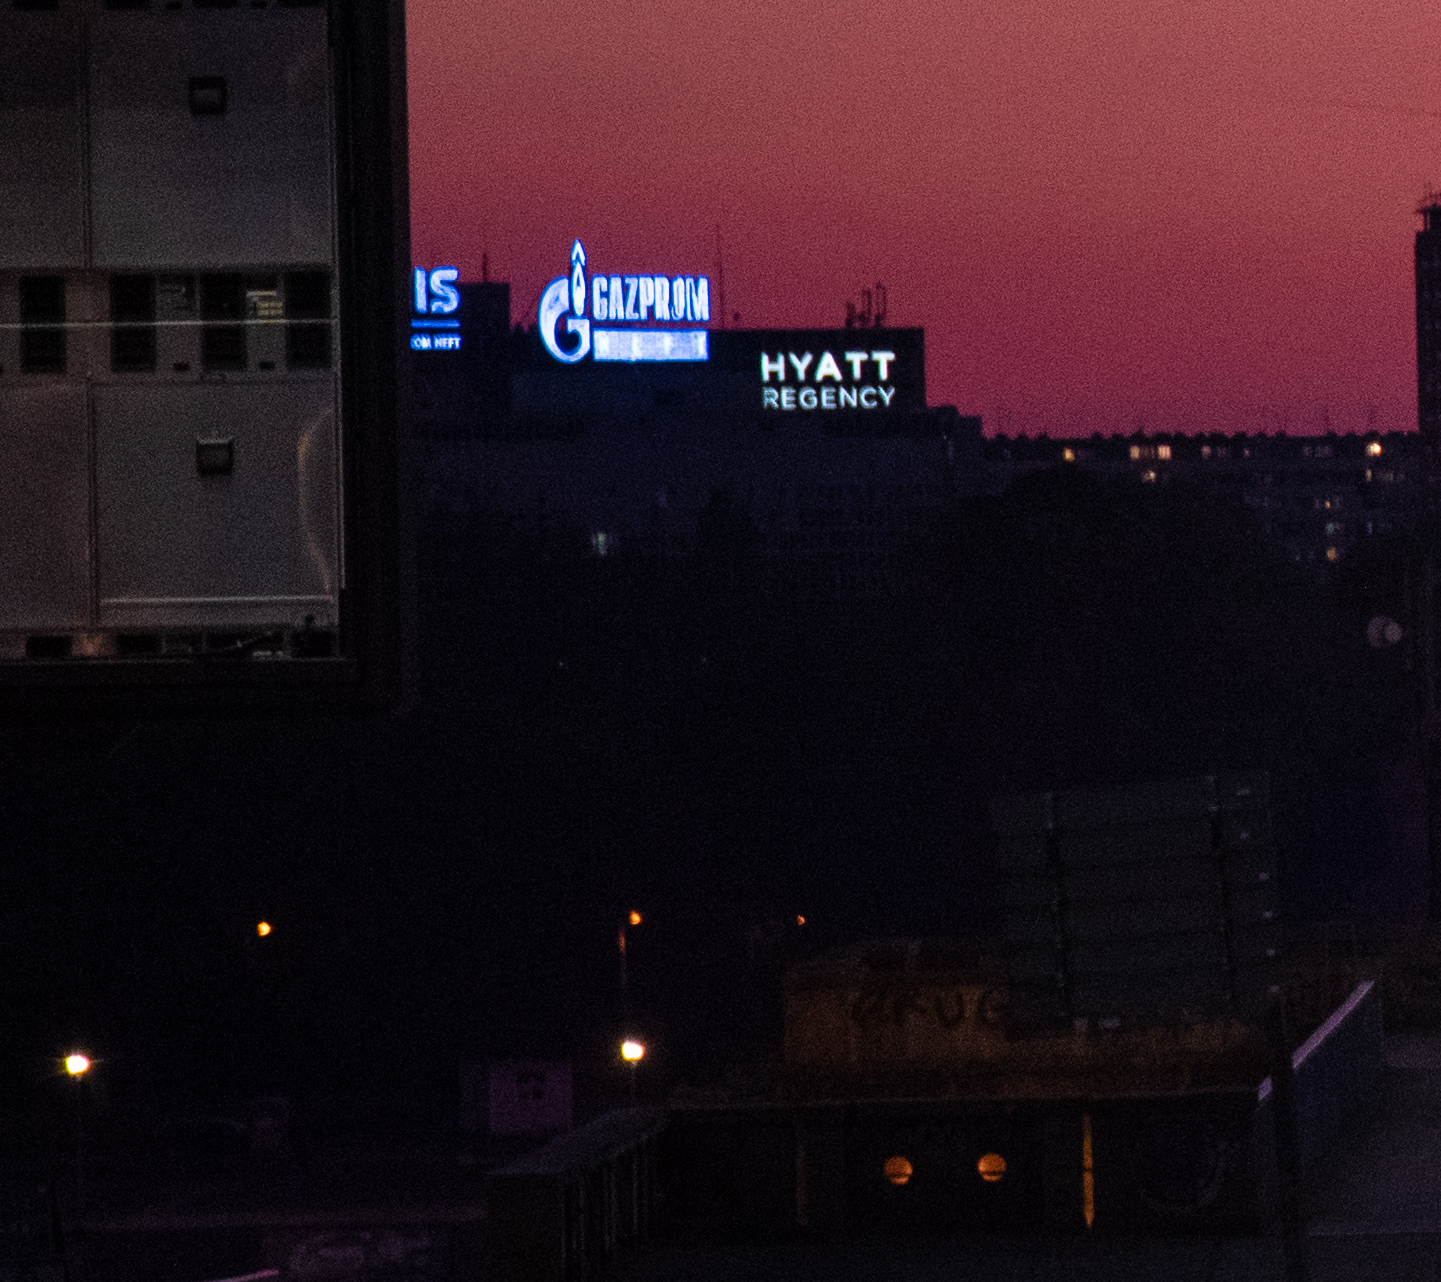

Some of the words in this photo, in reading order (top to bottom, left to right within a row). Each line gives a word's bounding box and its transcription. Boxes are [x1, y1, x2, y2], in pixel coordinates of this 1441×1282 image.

[592, 275, 709, 321] GAZPROM
[760, 351, 895, 382] HYATT
[762, 387, 895, 409] REGENCY
